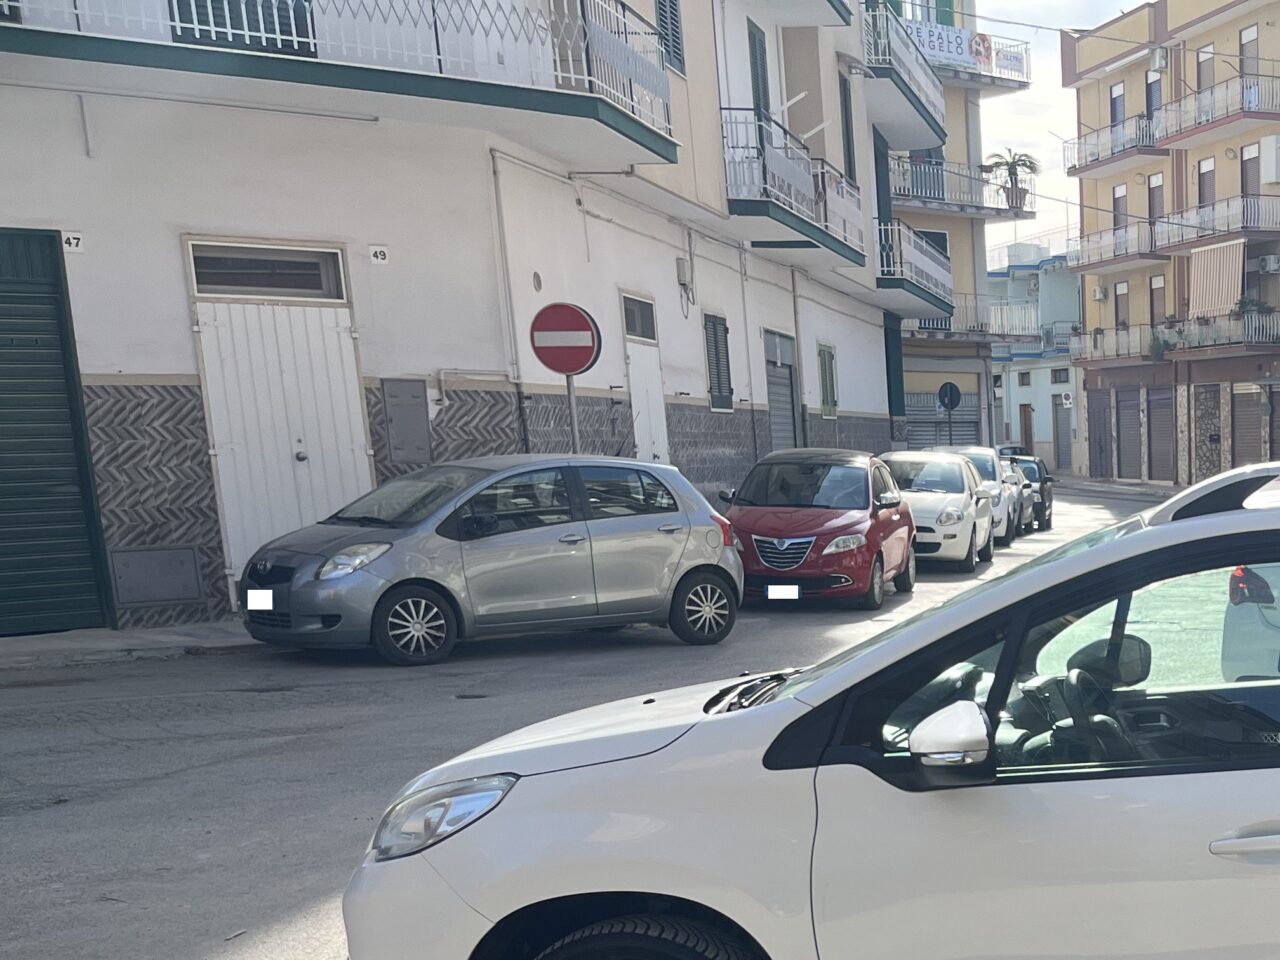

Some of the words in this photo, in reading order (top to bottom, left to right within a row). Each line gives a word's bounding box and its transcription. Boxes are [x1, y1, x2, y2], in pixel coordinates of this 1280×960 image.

[906, 25, 923, 38] DE
[928, 30, 963, 46] PALO
[918, 39, 964, 56] NGELO
[64, 236, 81, 248] 47
[372, 250, 387, 261] 49
